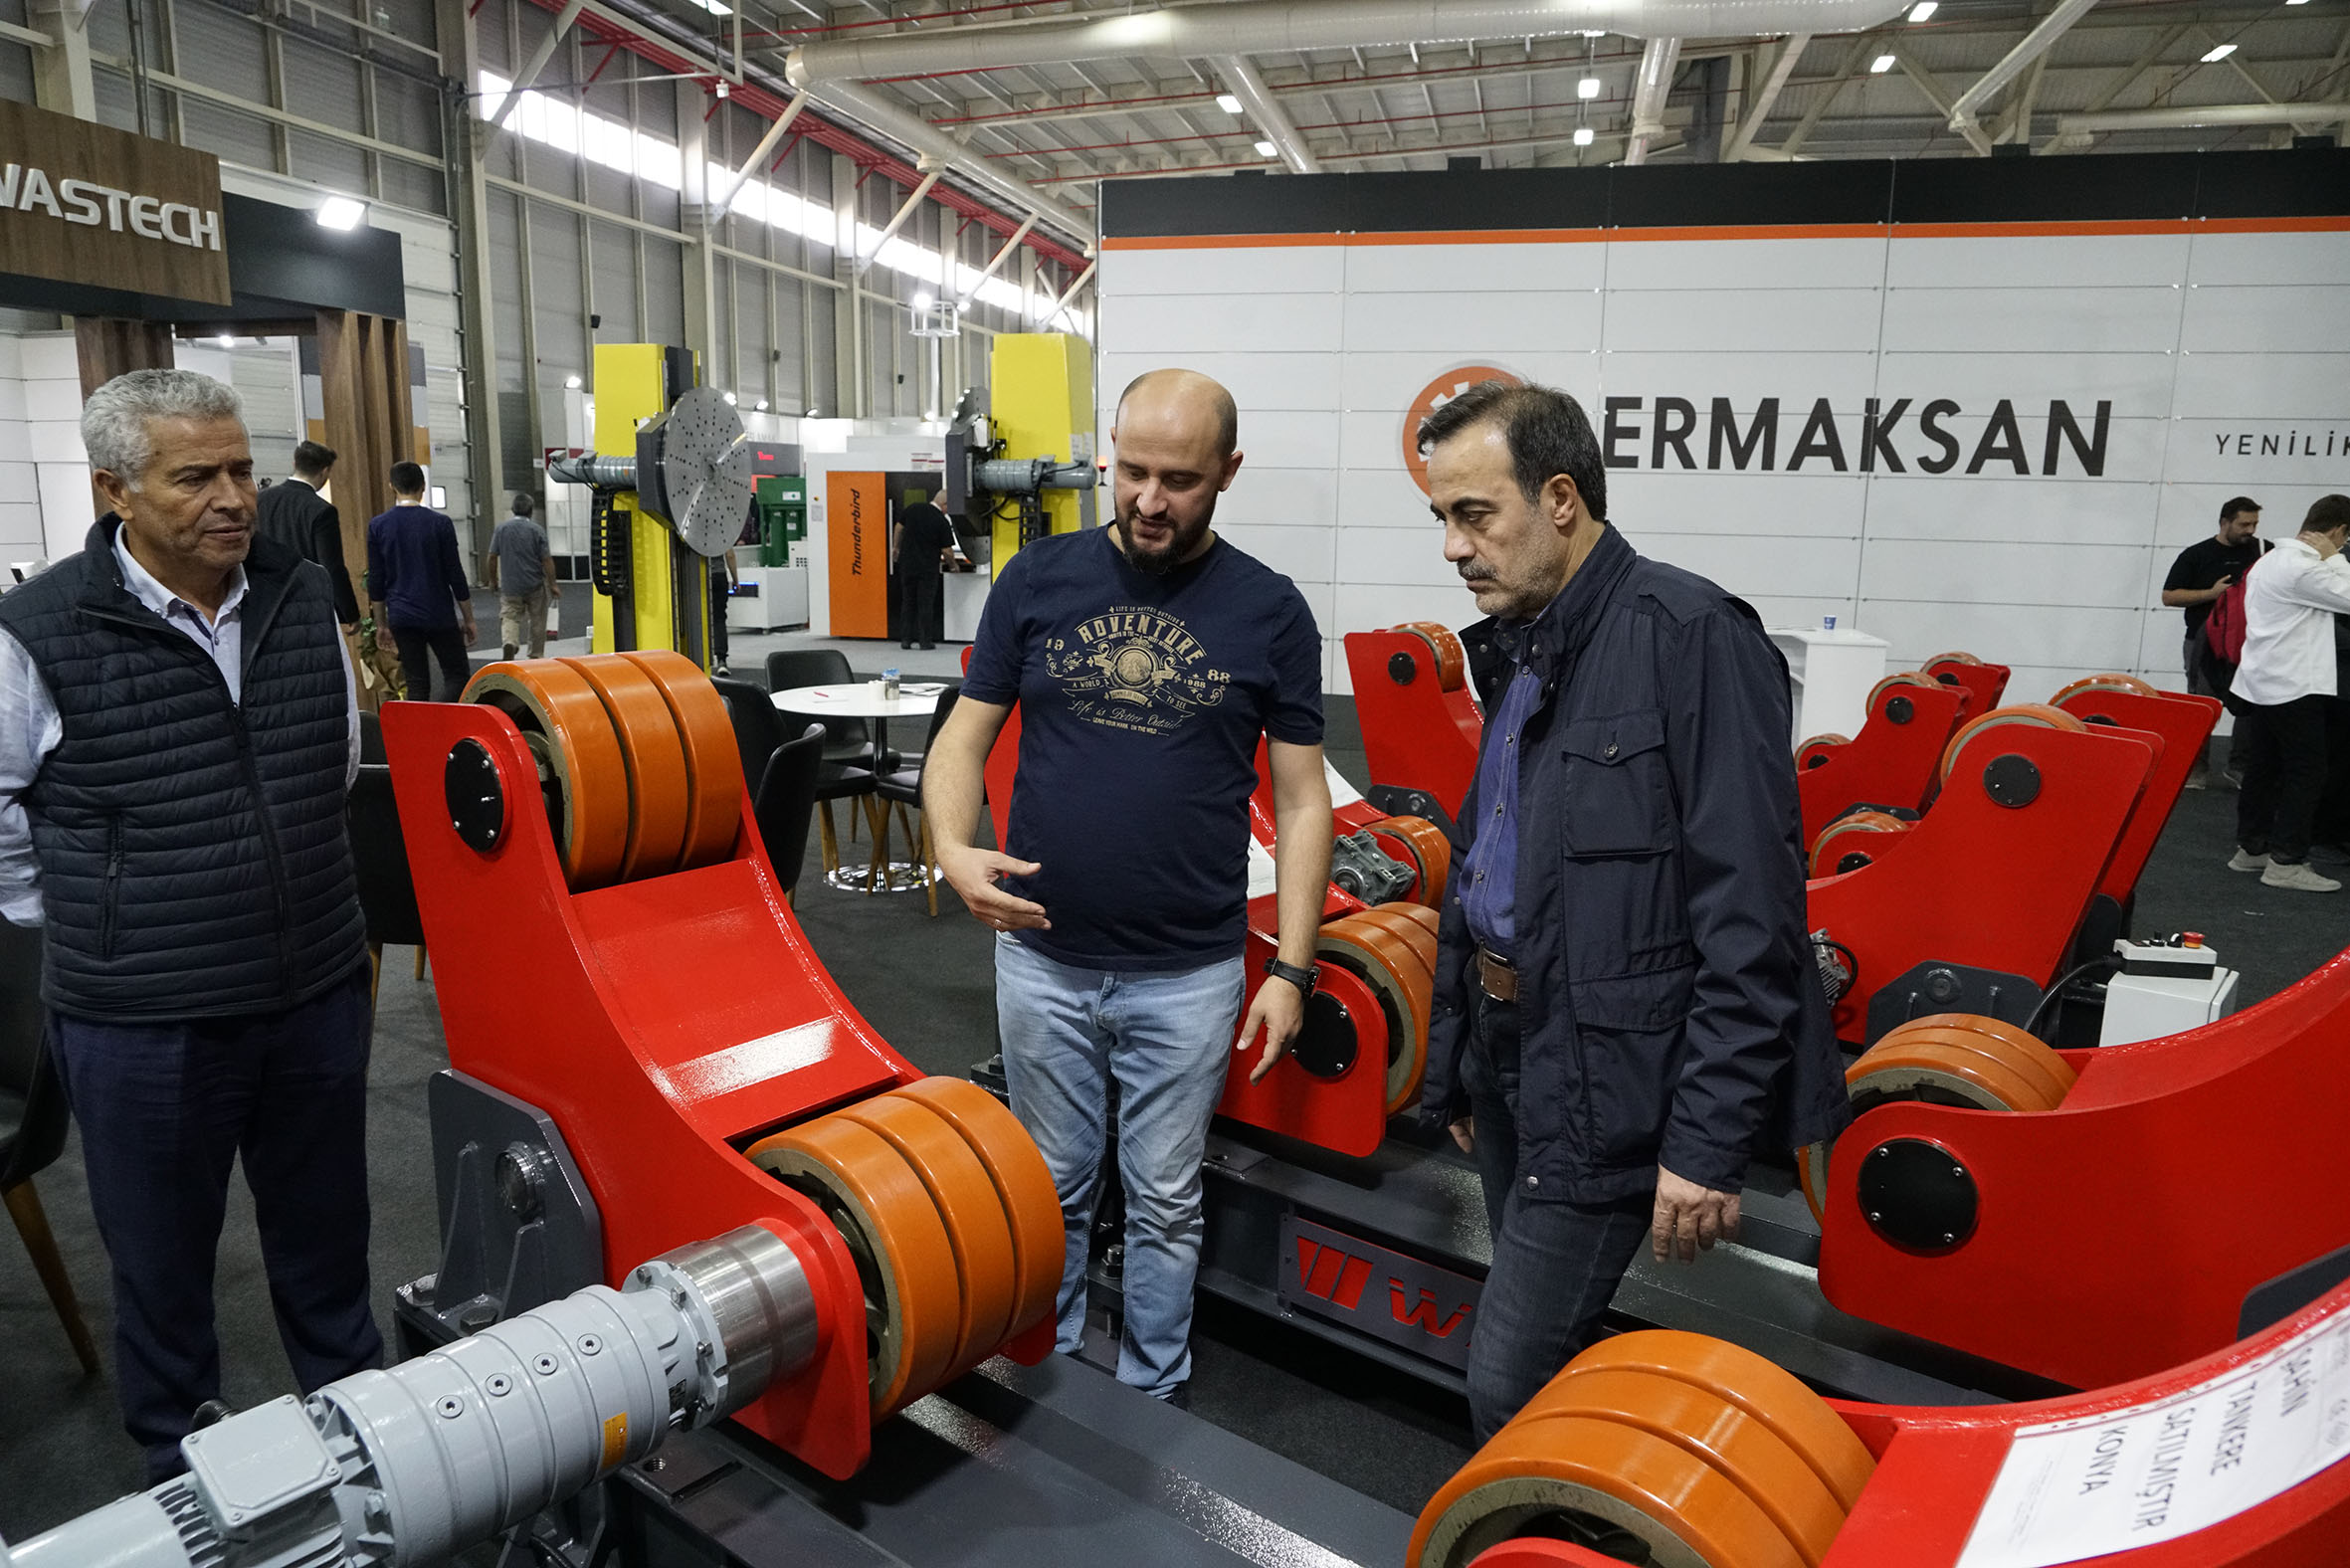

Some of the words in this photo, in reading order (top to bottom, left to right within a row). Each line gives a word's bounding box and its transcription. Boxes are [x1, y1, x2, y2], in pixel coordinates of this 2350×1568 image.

[1603, 396, 2112, 478] ERMAKSAN
[850, 488, 862, 576] Thunderbird
[1045, 638, 1065, 652] 19
[1077, 614, 1205, 666] ADVENTURE
[1079, 679, 1100, 688] WORLD
[1183, 679, 1206, 688] 1988
[1207, 669, 1232, 685] 88
[1068, 700, 1094, 716] Life
[1095, 707, 1106, 716] is
[1109, 707, 1144, 723] Better
[1166, 695, 1174, 704] TO
[1175, 699, 1187, 709] SEE
[2210, 1380, 2257, 1476] TANKERE
[2078, 1425, 2129, 1496] KONYA
[2131, 1406, 2198, 1532] SATILMIŞTIR
